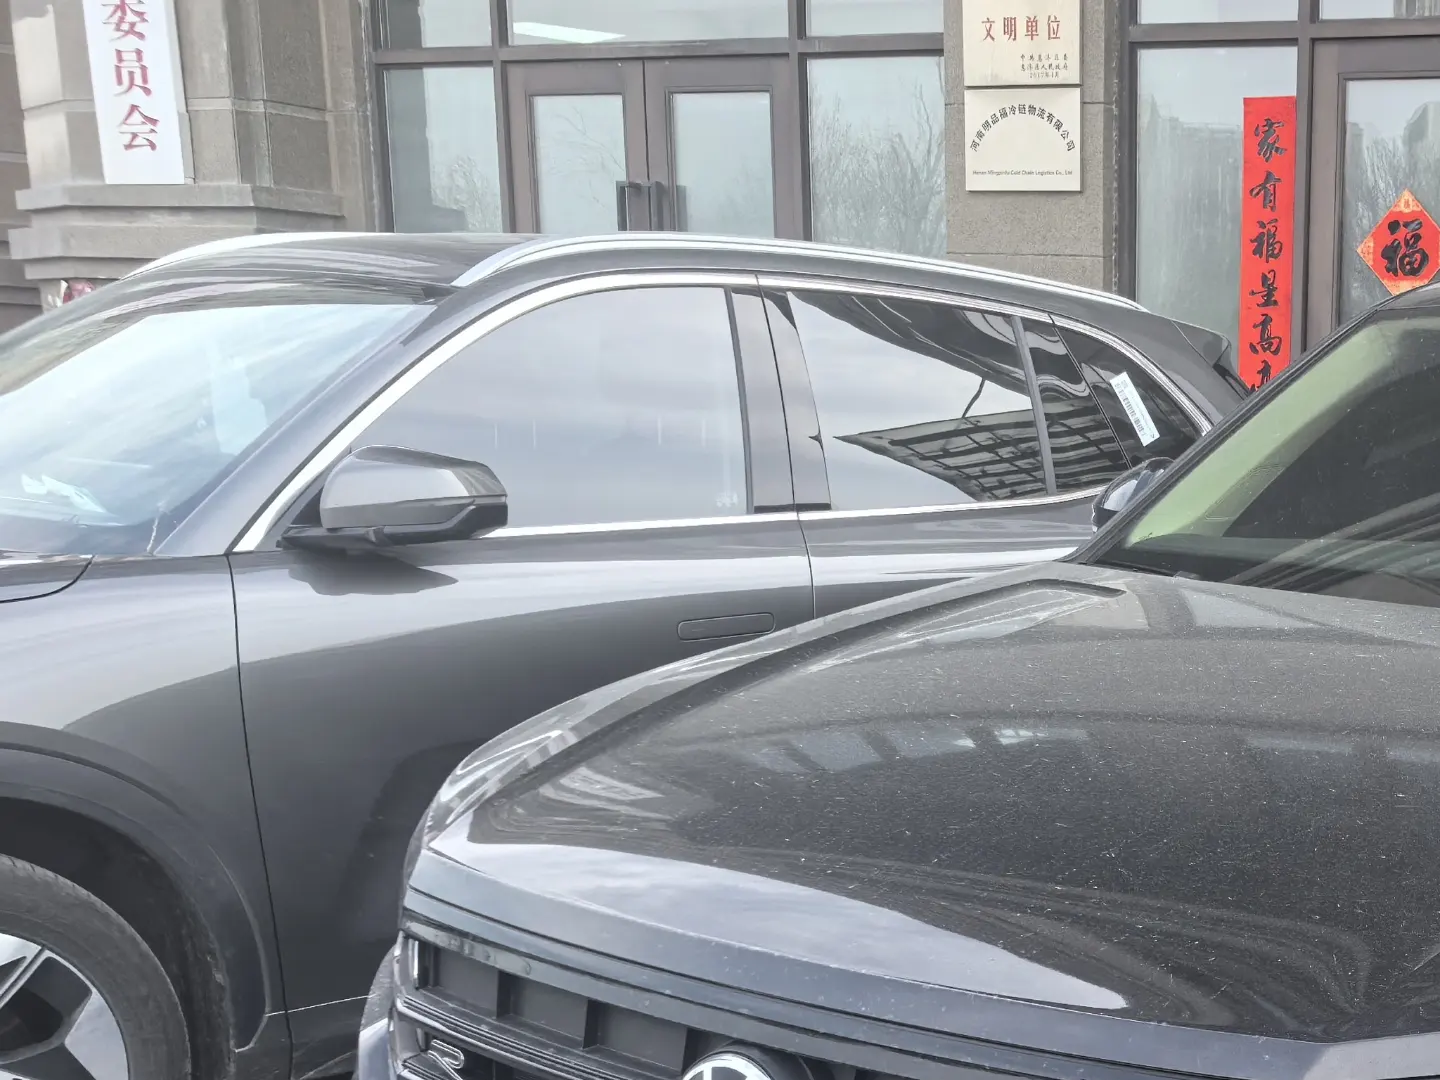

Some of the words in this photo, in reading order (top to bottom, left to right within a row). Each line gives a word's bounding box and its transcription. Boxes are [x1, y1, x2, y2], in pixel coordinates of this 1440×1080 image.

[981, 15, 1061, 41] 文明单位
[102, 0, 160, 151] 委员会
[1381, 219, 1429, 277] 福
